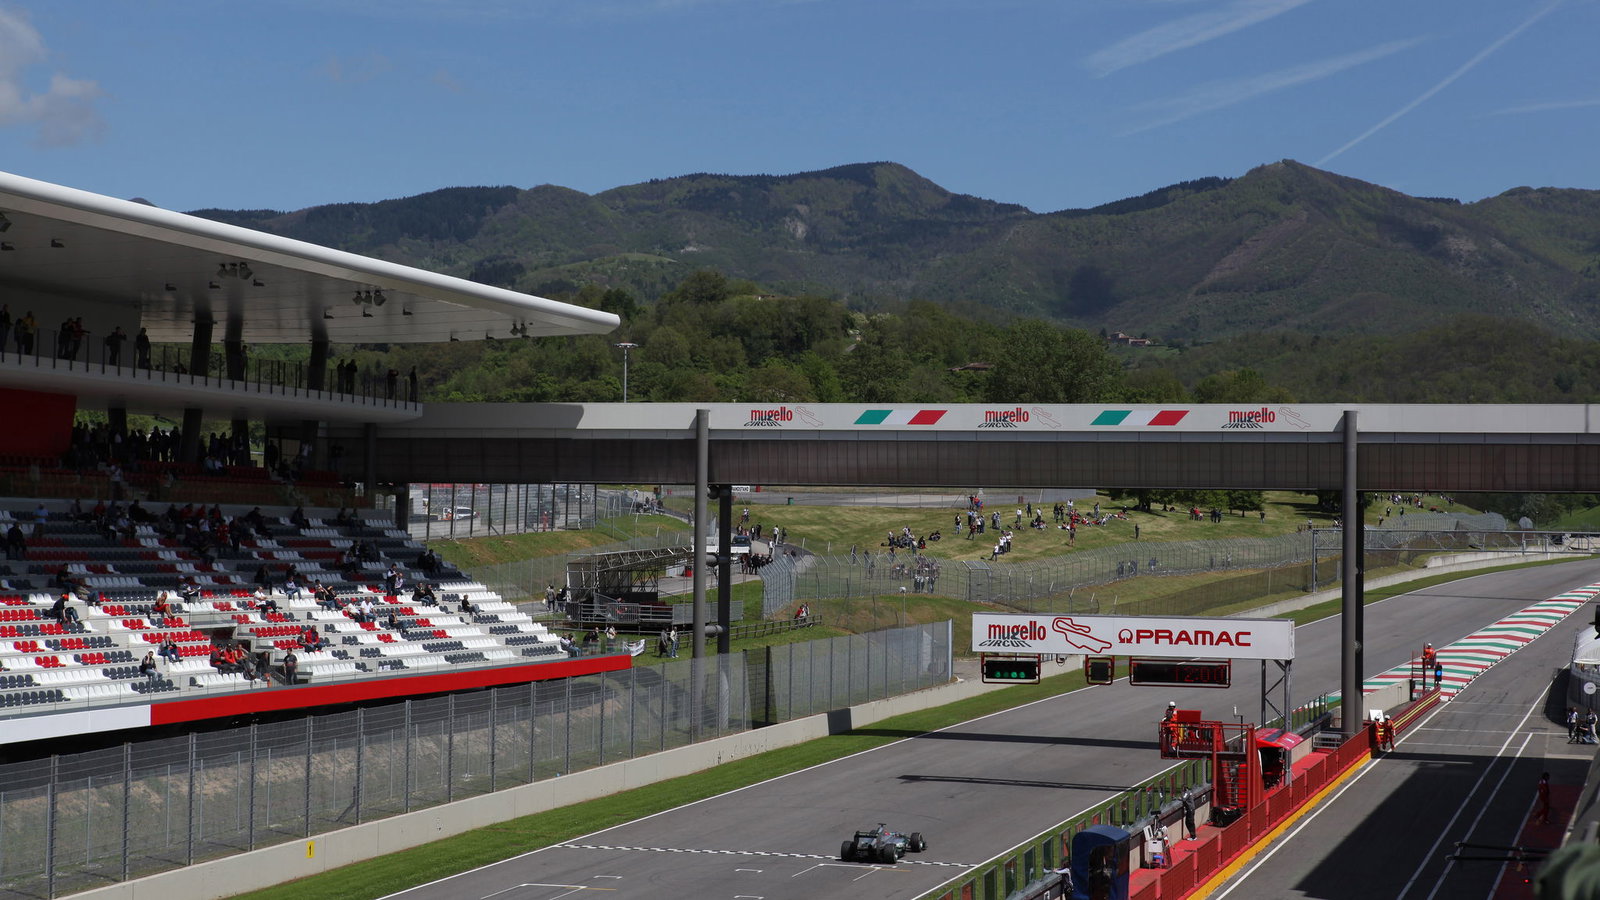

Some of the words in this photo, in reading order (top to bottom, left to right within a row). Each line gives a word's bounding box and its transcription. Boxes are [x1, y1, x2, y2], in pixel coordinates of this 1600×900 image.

[750, 406, 793, 422] mugello
[984, 407, 1029, 423] mugello
[1229, 407, 1276, 423] mugello
[1220, 421, 1264, 429] CIRCUIT
[988, 620, 1047, 641] mugello
[1135, 629, 1252, 647] PRAMAC
[978, 639, 1032, 648] CIRCUIT
